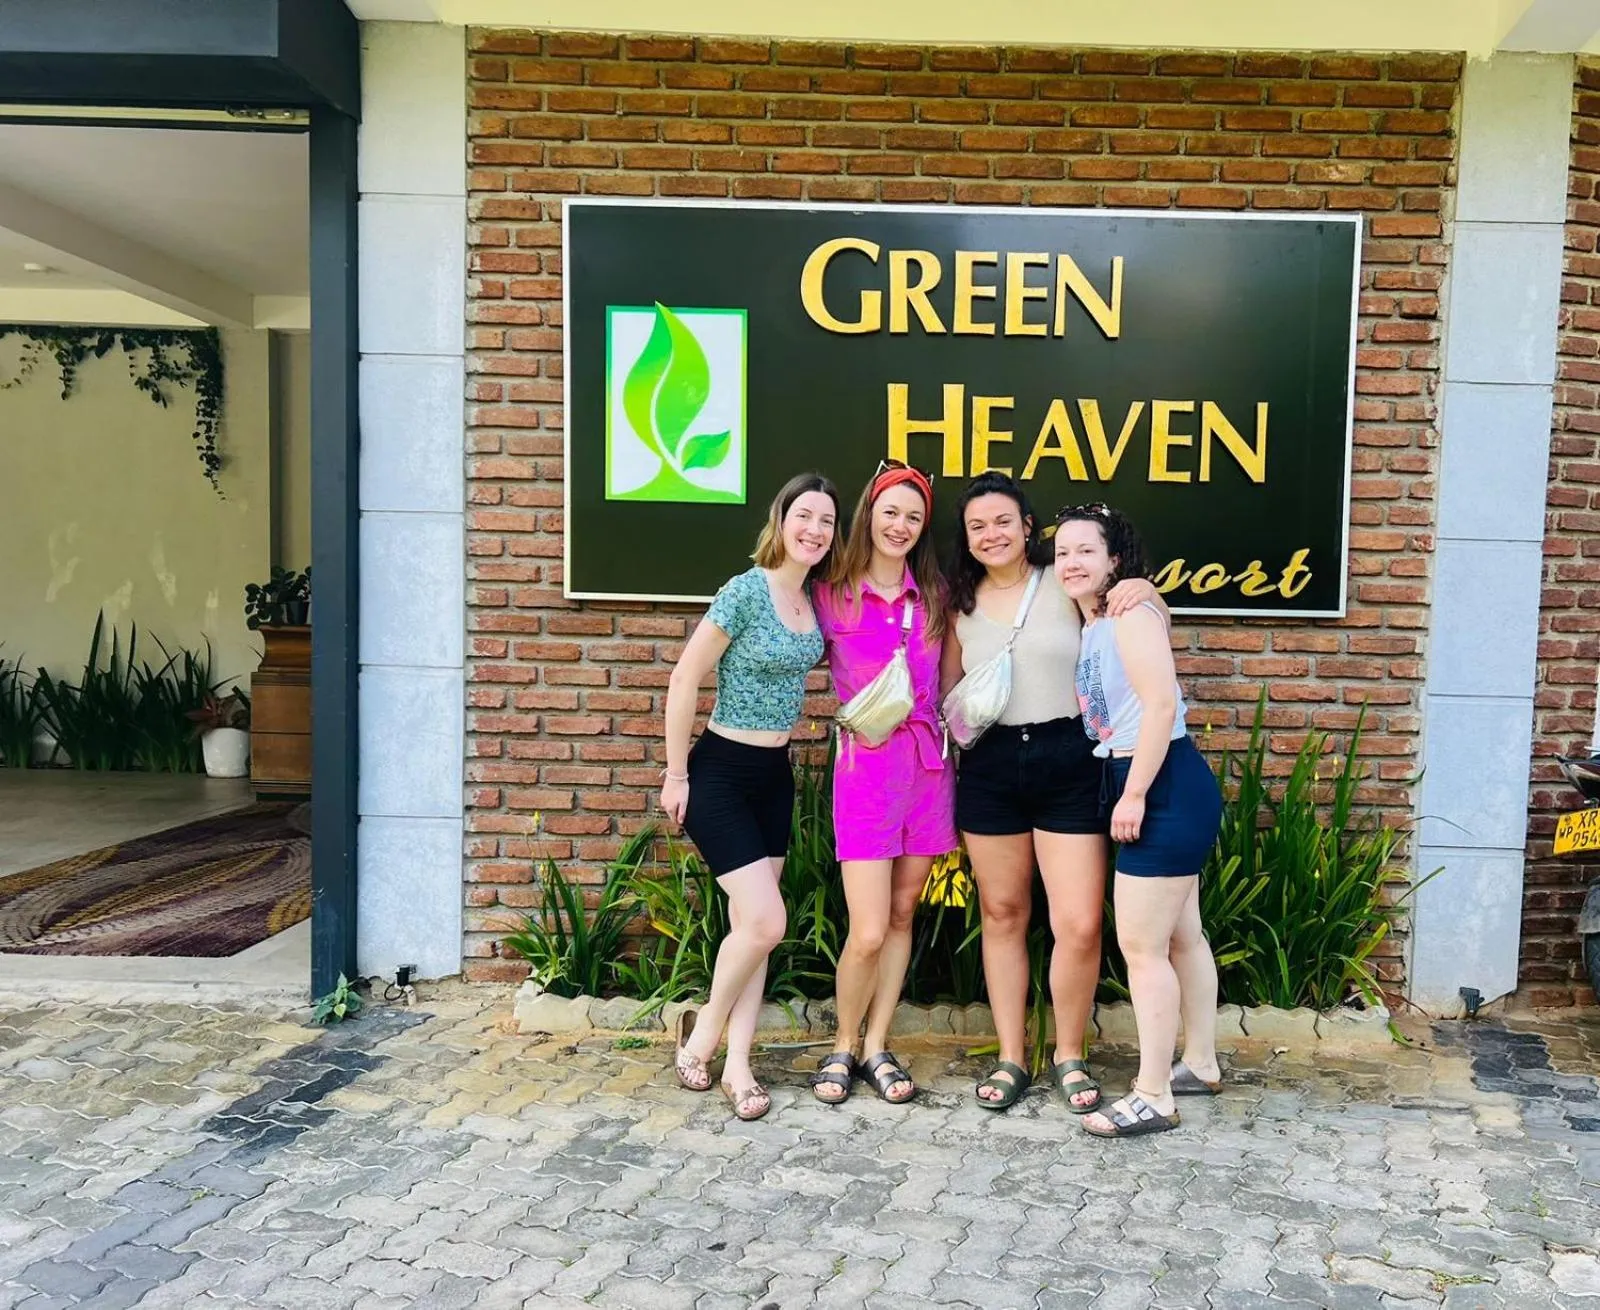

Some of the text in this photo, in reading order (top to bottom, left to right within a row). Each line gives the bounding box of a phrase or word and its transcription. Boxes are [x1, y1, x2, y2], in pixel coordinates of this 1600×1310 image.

[800, 237, 1124, 340] GREEN
[886, 382, 1269, 484] HEAVEN
[1148, 547, 1313, 599] sort
[1571, 829, 1600, 849] 954
